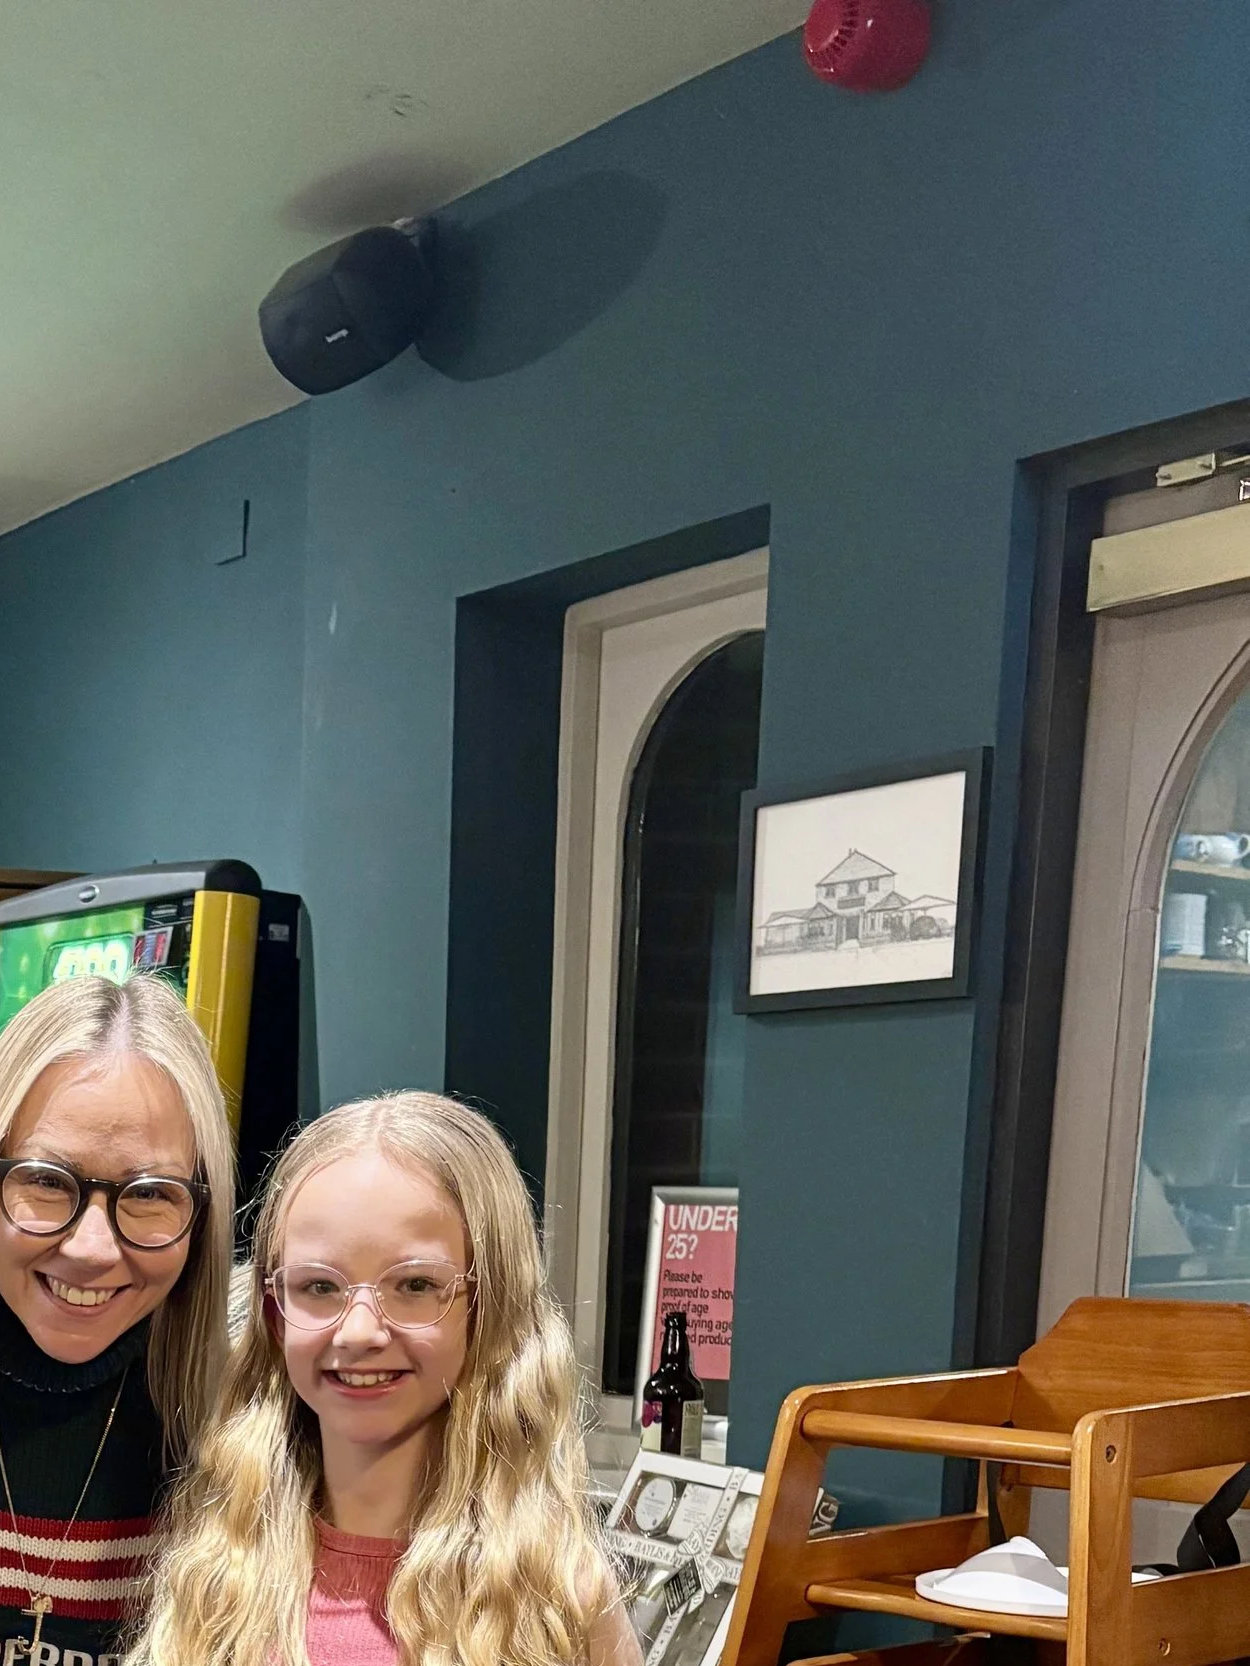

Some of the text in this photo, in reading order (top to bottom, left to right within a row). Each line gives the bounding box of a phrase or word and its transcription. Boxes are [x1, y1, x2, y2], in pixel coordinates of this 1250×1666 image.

[668, 1205, 739, 1232] UNDER
[666, 1233, 698, 1260] 25?
[663, 1269, 703, 1284] Please be
[662, 1286, 699, 1300] prepared
[700, 1287, 710, 1299] to
[661, 1301, 709, 1318] proof of age
